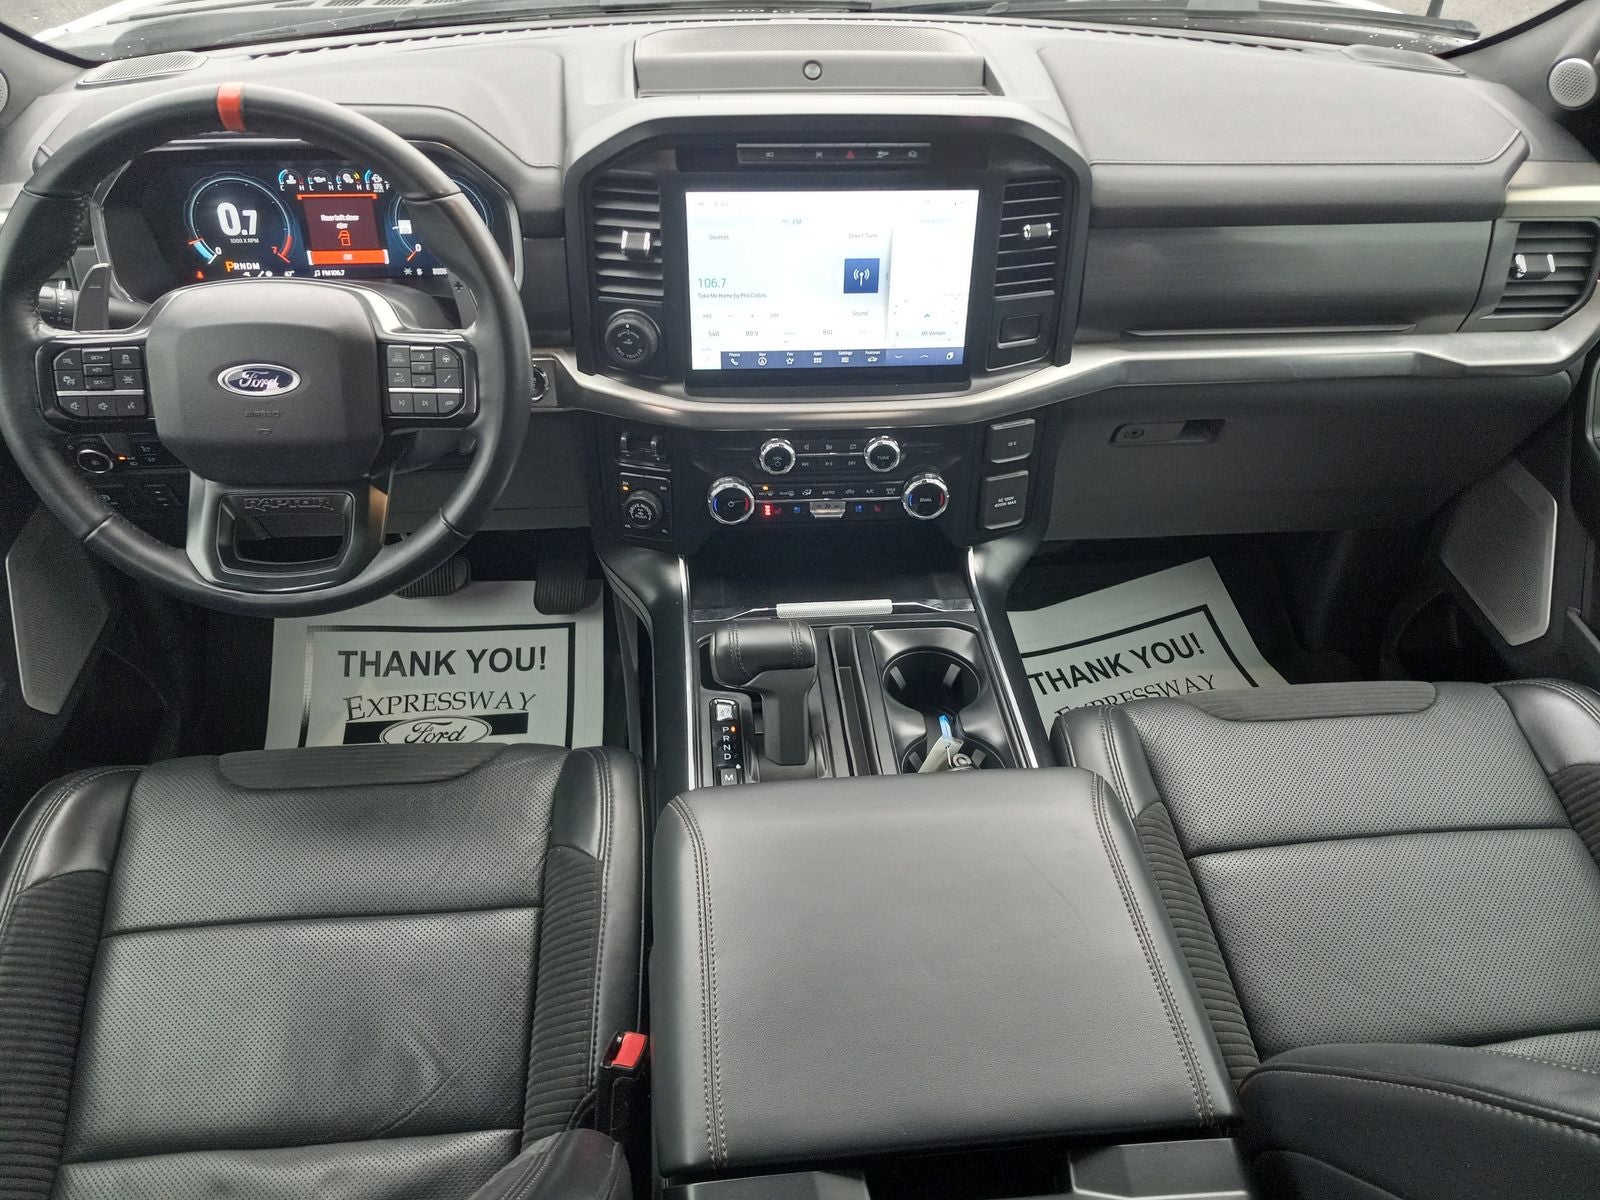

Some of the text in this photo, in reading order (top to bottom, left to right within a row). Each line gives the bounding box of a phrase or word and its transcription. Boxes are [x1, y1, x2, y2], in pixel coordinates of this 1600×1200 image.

[217, 202, 257, 236] 0.7
[708, 233, 730, 241] Sources
[215, 247, 222, 255] 0
[698, 277, 727, 288] 106.7
[734, 292, 740, 300] by
[238, 369, 279, 389] Ford
[243, 497, 334, 512] RAPTOR
[337, 645, 546, 678] THANK YOU!
[1027, 632, 1205, 696] THANK YOU!
[342, 690, 537, 721] EXPRESSWAY
[404, 721, 468, 744] Ford
